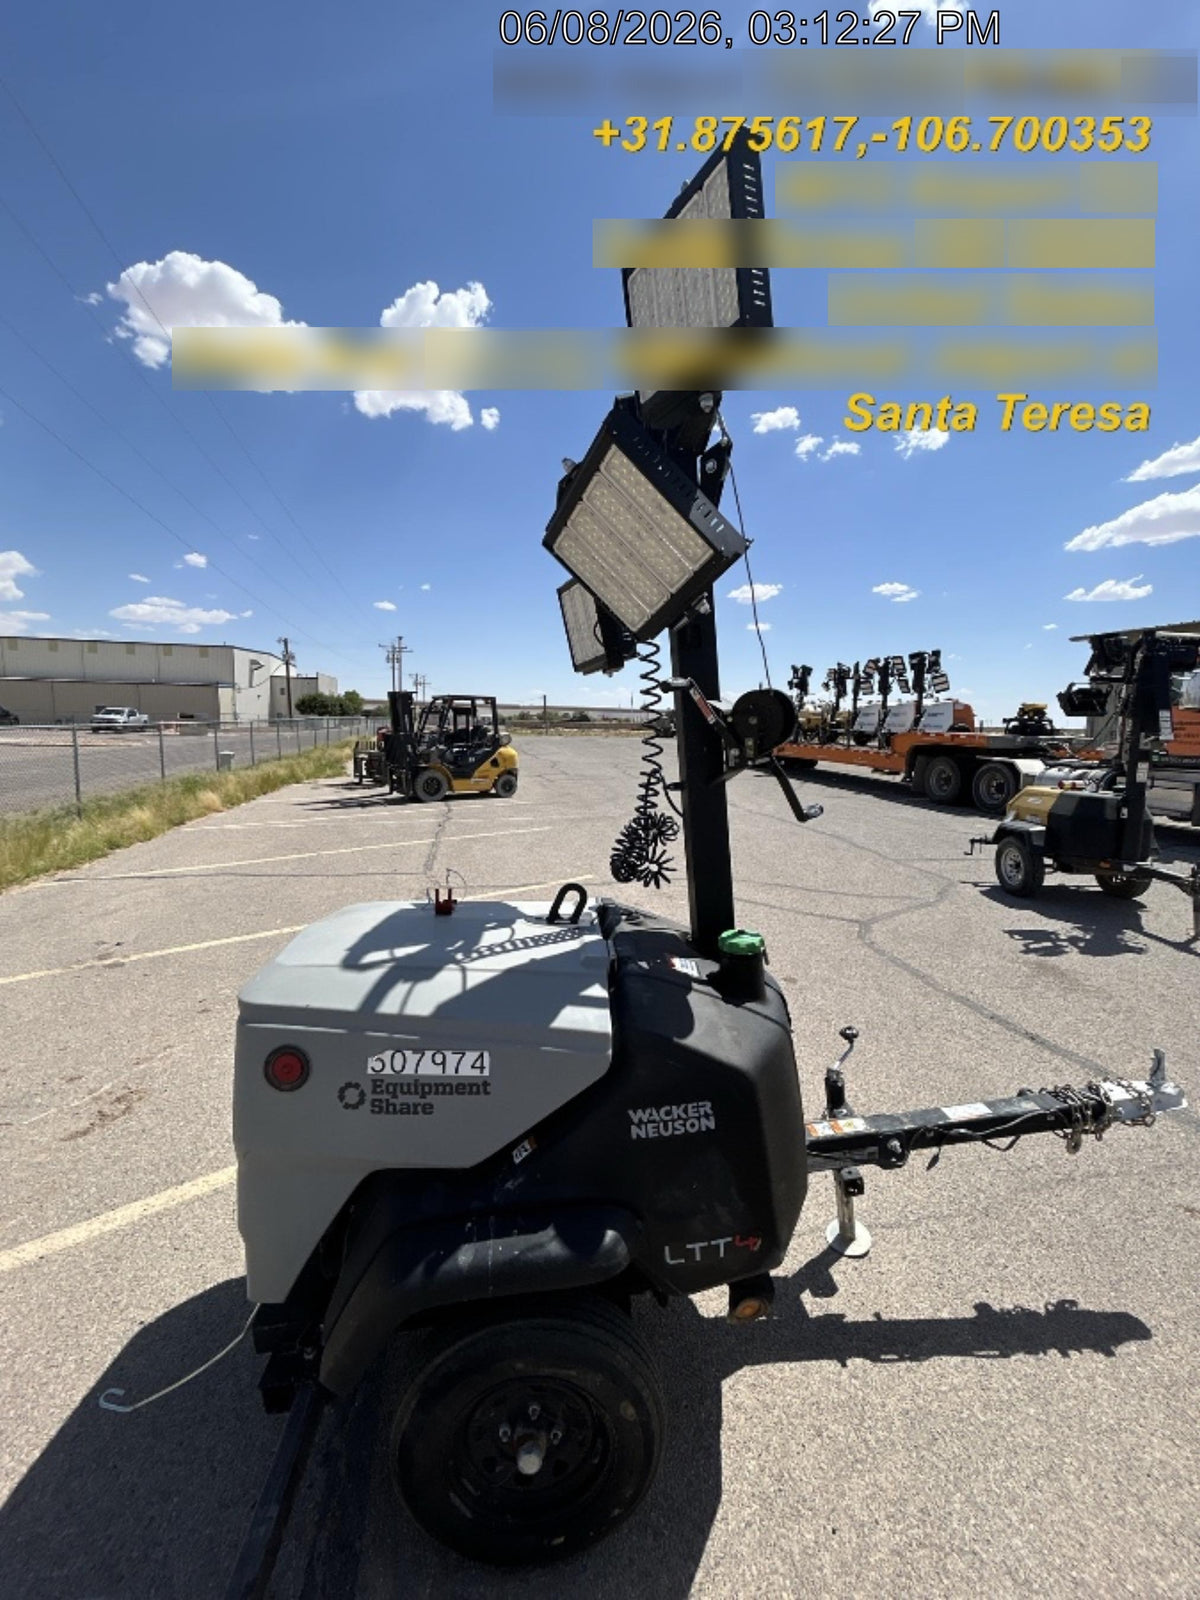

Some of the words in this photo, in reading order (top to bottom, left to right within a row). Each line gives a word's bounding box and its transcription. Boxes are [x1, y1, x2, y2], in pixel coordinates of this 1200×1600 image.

[371, 1078, 491, 1099] Equipment
[370, 1098, 434, 1115] Share
[628, 1101, 714, 1124] WACKER
[630, 1116, 716, 1140] NEUSON
